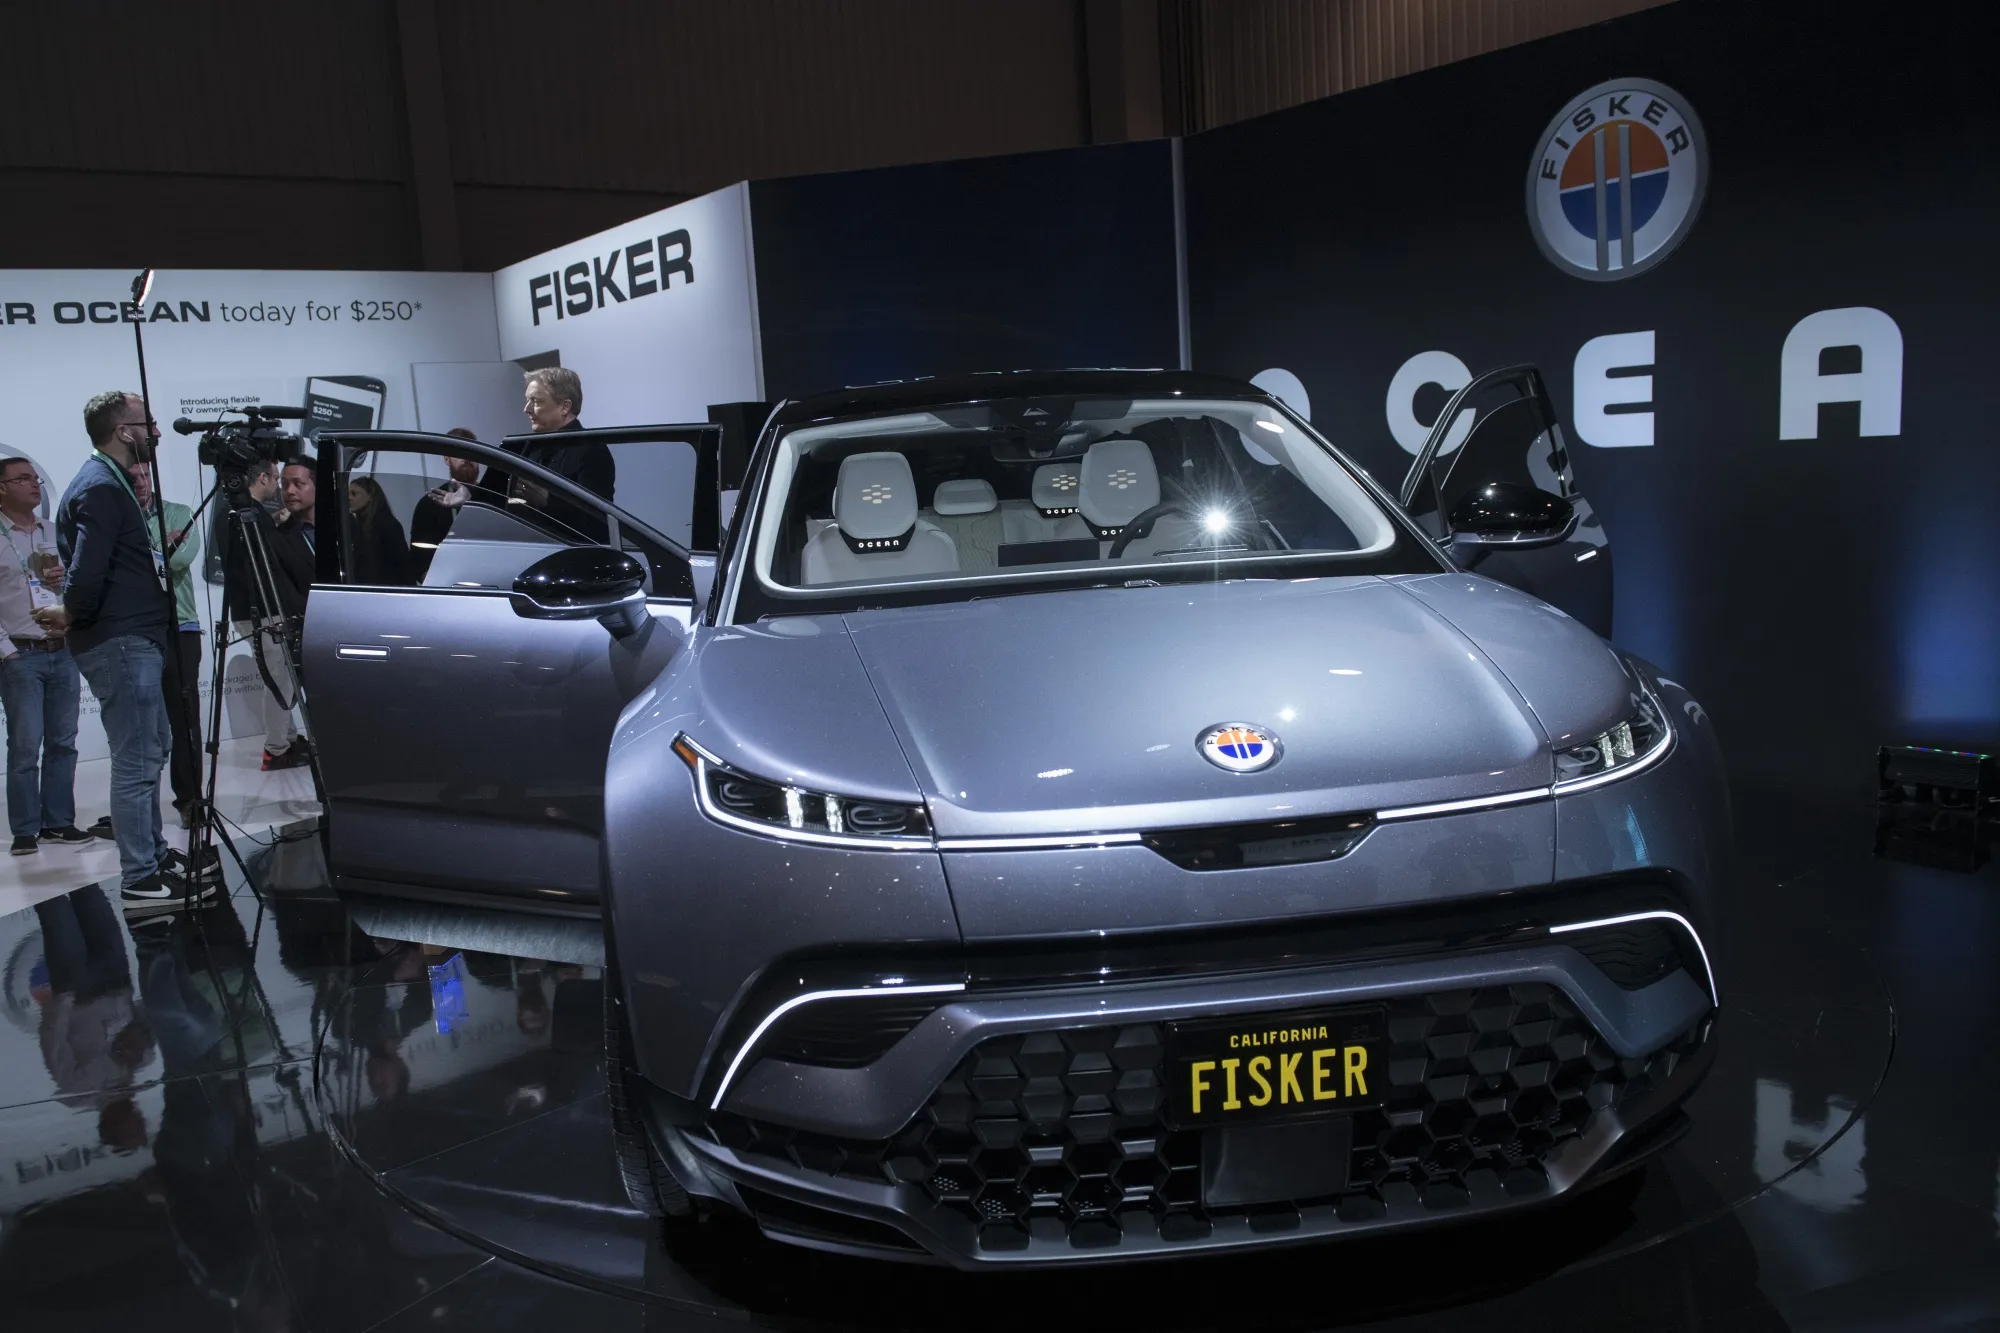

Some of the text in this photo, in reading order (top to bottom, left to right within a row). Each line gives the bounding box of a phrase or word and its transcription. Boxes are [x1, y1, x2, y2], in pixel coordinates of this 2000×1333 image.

[1541, 94, 1690, 180] FISKER
[529, 228, 695, 326] FISKER
[0, 302, 36, 325] R
[53, 301, 211, 324] OCEAN
[220, 301, 296, 326] today
[305, 300, 341, 321] for
[180, 395, 261, 406] Introducing flexible
[312, 405, 333, 416] $250
[181, 407, 194, 415] EV
[858, 539, 900, 549] OCEAN
[1206, 726, 1268, 745] FISKER
[1230, 1026, 1328, 1048] CALIFORNIA
[1191, 1046, 1368, 1114] FISKER
